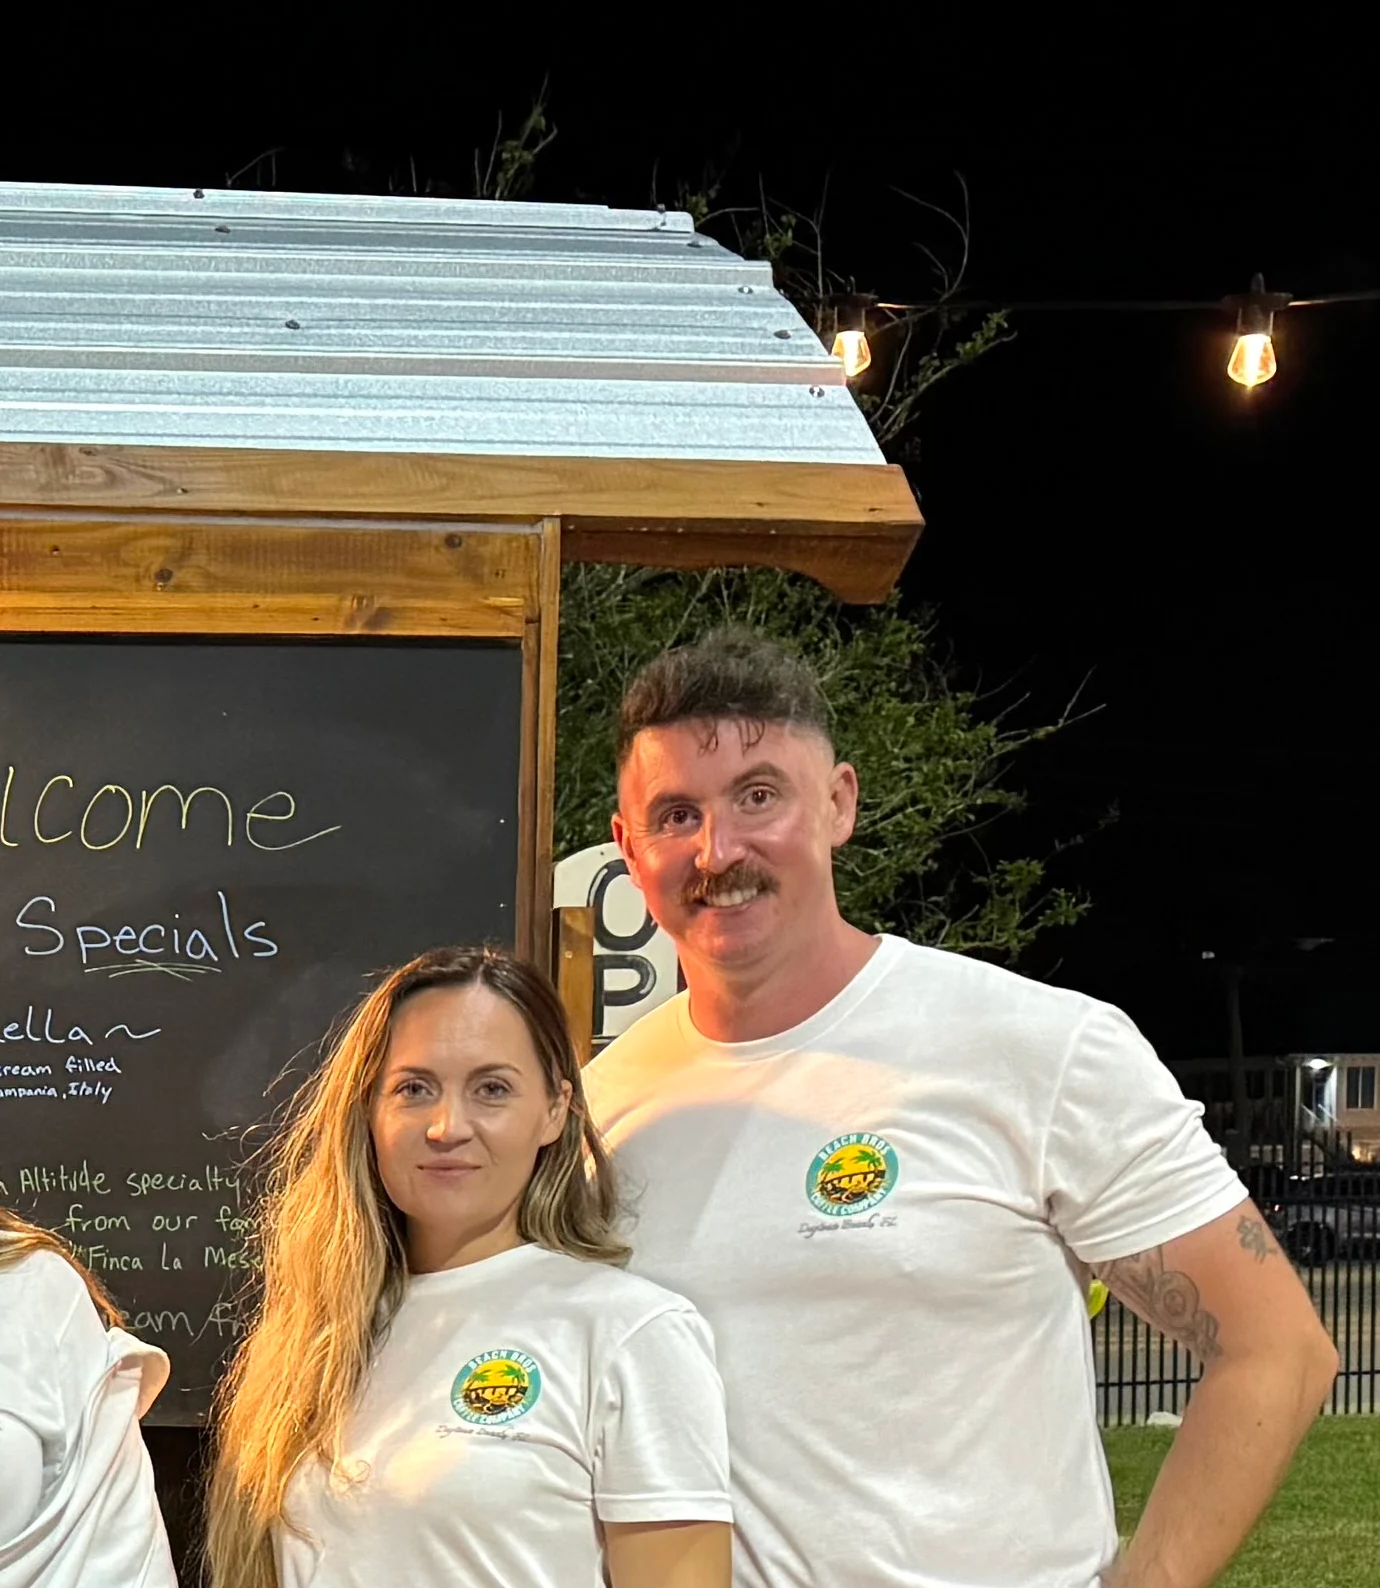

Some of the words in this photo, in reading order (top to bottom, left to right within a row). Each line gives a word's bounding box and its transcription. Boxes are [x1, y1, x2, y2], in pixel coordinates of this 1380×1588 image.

[17, 891, 278, 964] Specials
[65, 1054, 122, 1076] filled
[818, 1134, 857, 1160] BEACH
[861, 1133, 891, 1154] BROS
[19, 1160, 112, 1195] Altitude
[65, 1203, 131, 1232] from
[152, 1214, 198, 1231] our
[161, 1242, 183, 1270] La
